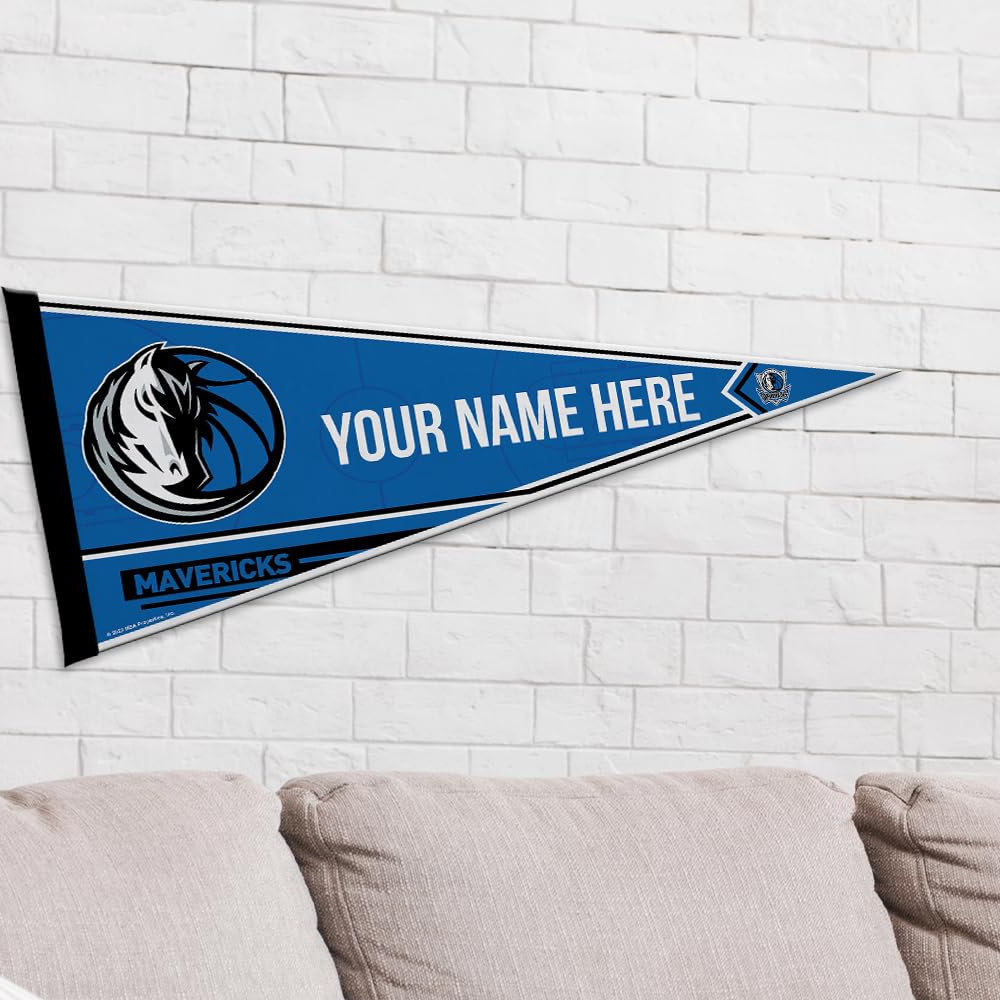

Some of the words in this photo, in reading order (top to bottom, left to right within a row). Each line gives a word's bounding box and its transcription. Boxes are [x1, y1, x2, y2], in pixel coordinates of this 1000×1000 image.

[322, 398, 449, 464] YOUR
[455, 387, 584, 449] NAME
[591, 373, 700, 432] HERE
[133, 553, 292, 596] MAVERICKS
